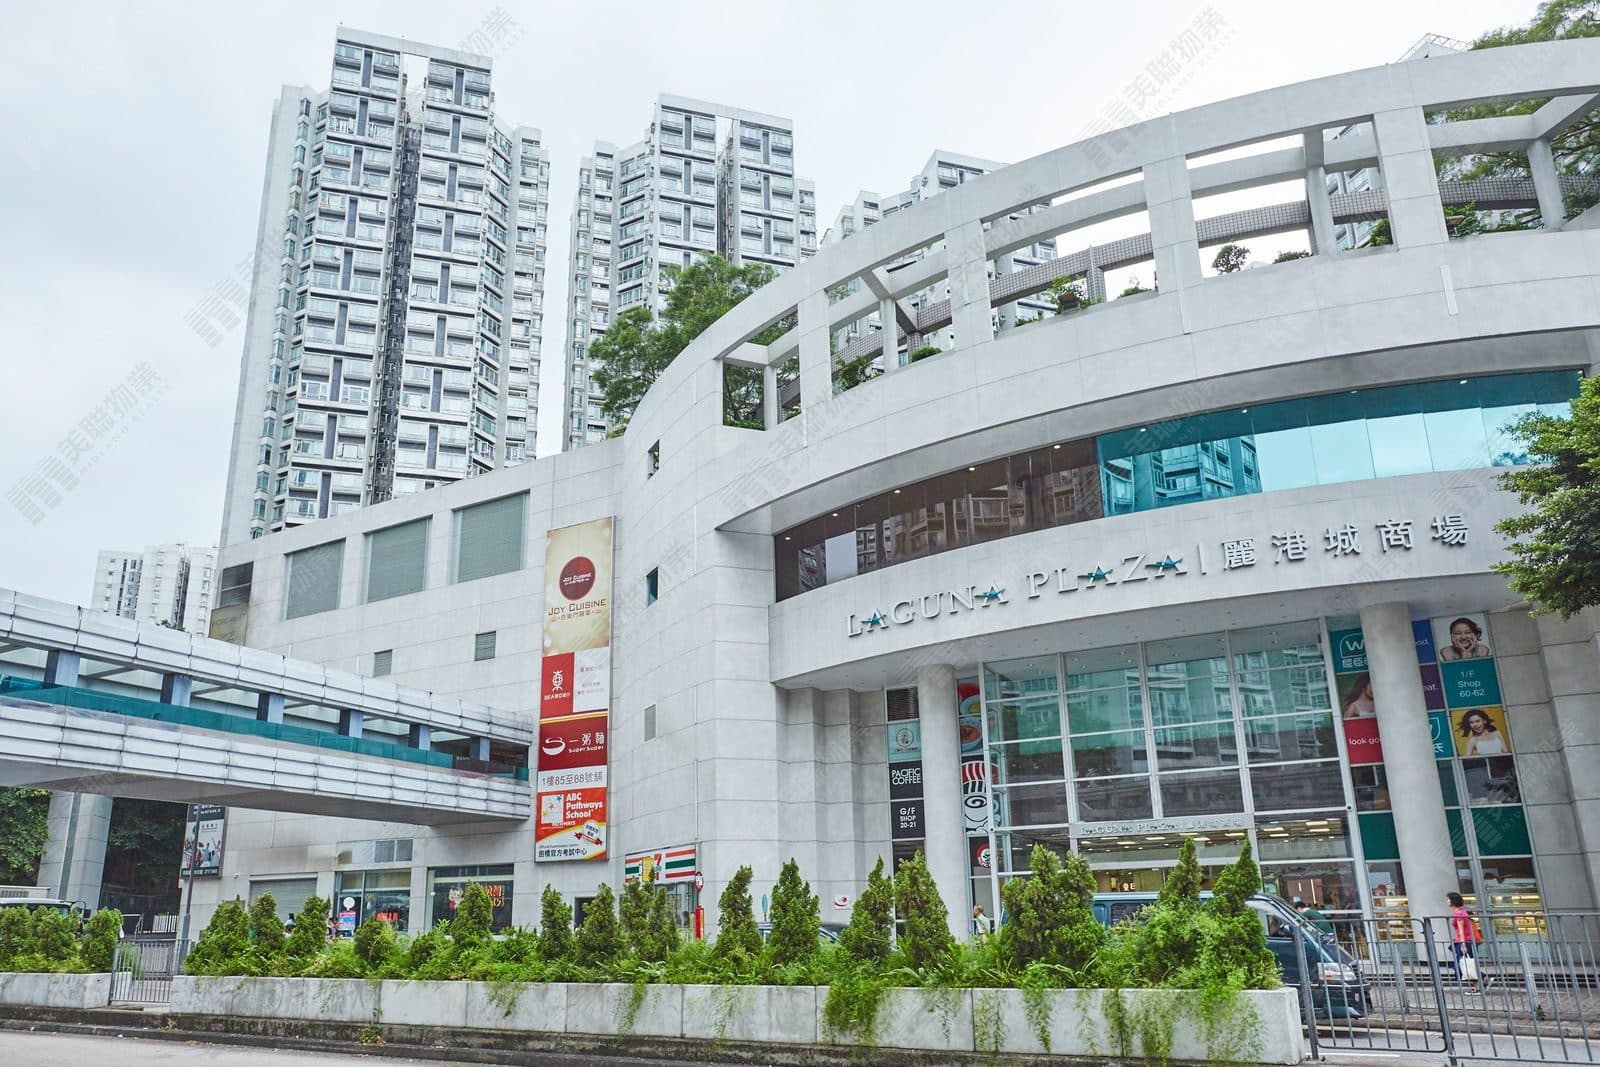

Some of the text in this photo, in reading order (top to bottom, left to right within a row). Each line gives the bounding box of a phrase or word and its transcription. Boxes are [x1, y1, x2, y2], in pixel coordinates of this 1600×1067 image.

[847, 583, 1009, 638] LAGUNA
[1026, 552, 1188, 599] PLAZA
[1221, 514, 1469, 571] 麗港城商場
[548, 598, 607, 616] JOY CUISINE
[1460, 670, 1475, 678] 1/F
[1457, 680, 1481, 688] Shop
[1459, 688, 1486, 698] 60-62
[1349, 737, 1380, 745] look go
[891, 768, 921, 778] PACIFIC
[892, 776, 921, 785] COFFEE
[566, 792, 582, 802] ABC
[566, 801, 603, 811] Pathways
[899, 807, 916, 815] G/F
[566, 810, 591, 819] School
[1080, 824, 1133, 836] LAGUNA
[1137, 821, 1182, 832] PLAZA
